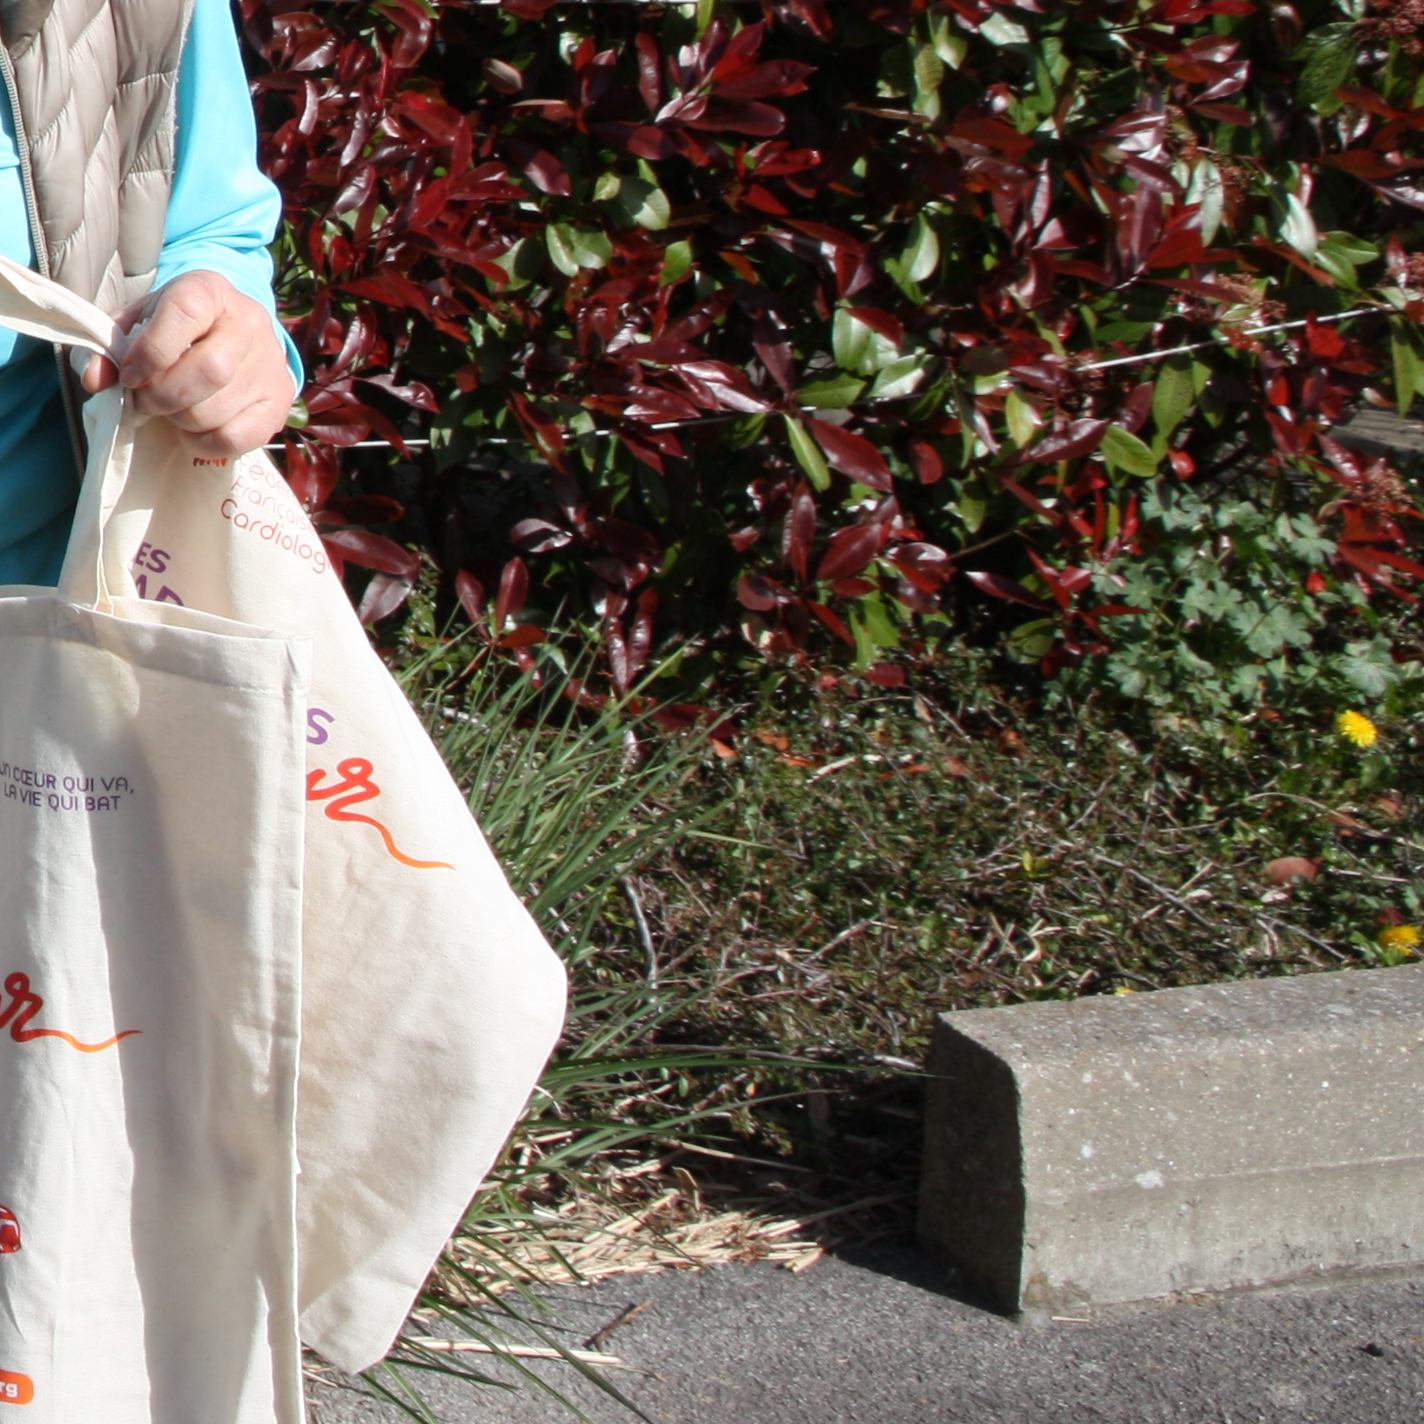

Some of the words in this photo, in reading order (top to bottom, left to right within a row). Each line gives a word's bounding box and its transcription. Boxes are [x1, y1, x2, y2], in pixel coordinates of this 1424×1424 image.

[13, 767, 57, 789] CŒUR
[63, 776, 94, 794] QUI
[100, 777, 135, 795] VA,
[4, 781, 17, 800] LA
[19, 788, 42, 807] VIE
[48, 794, 78, 811] QUI
[84, 795, 121, 811] BAT
